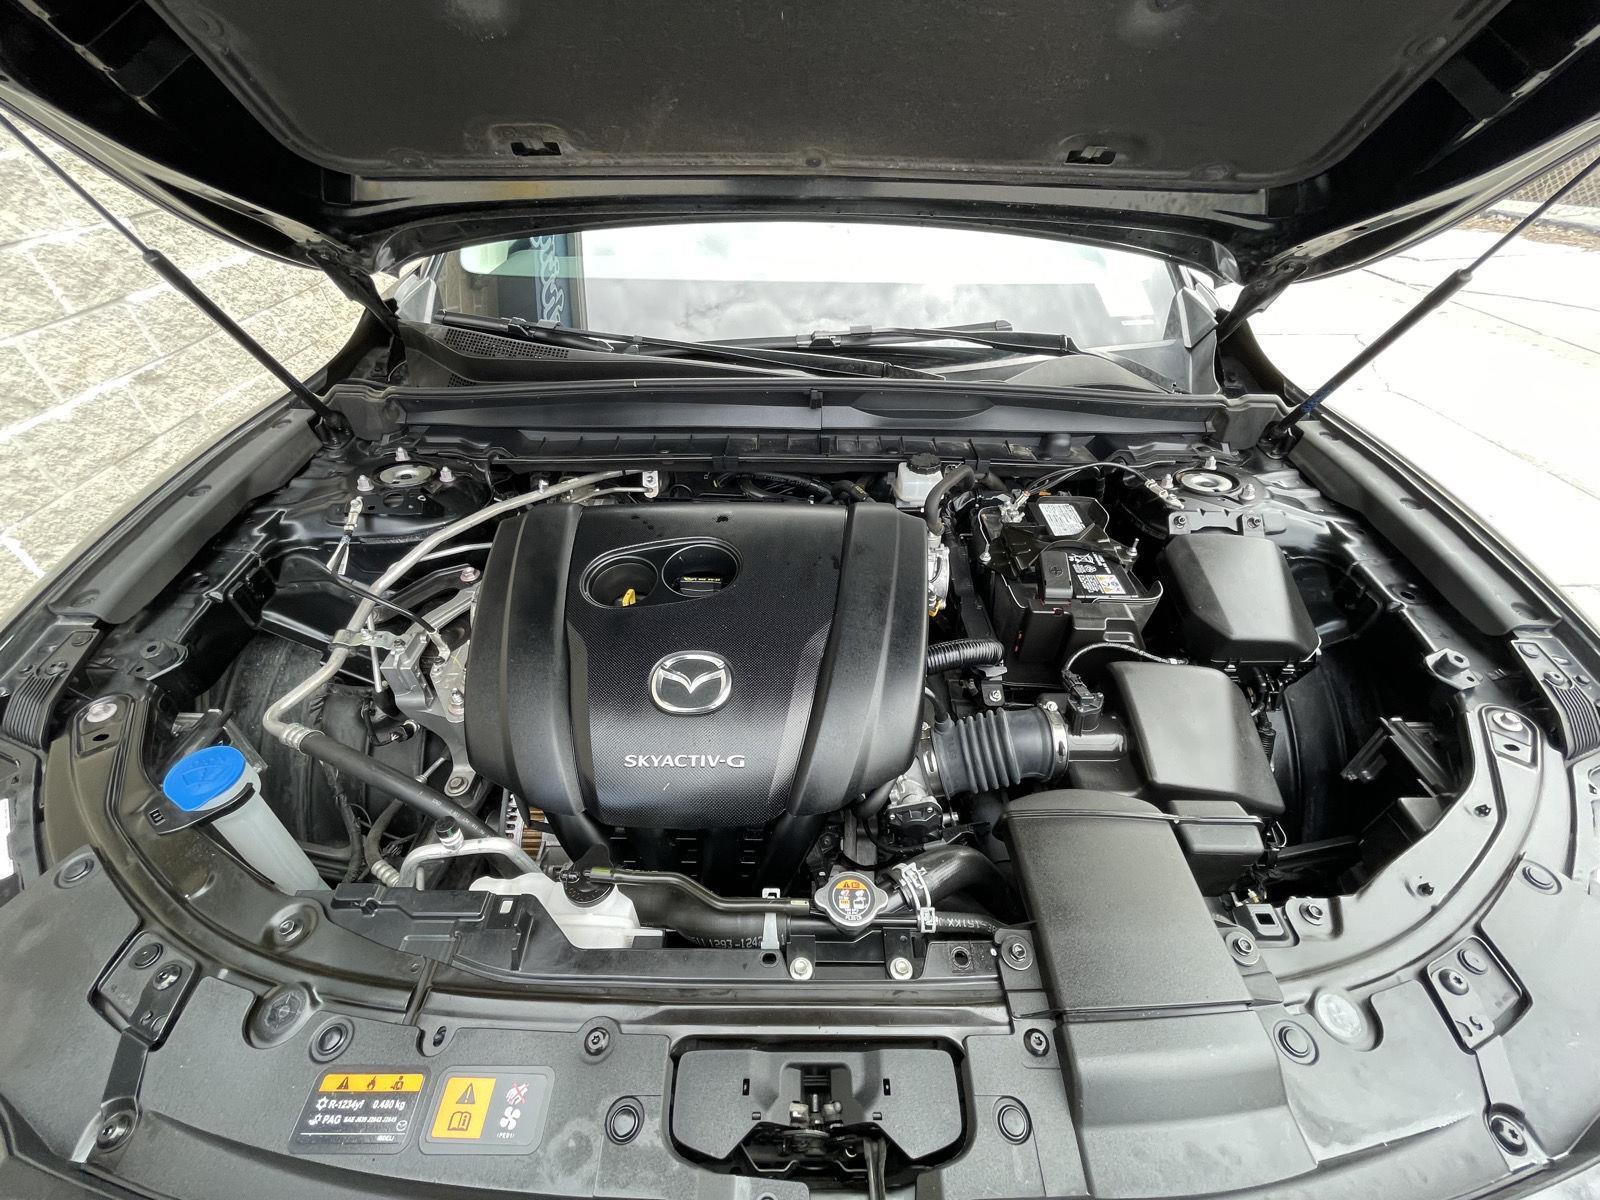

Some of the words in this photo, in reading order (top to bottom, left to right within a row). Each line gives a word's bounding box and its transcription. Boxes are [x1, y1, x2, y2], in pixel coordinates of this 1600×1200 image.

[623, 754, 746, 768] SKYACTIV-G
[395, 1099, 406, 1111] kg
[321, 1114, 342, 1125] PAG
